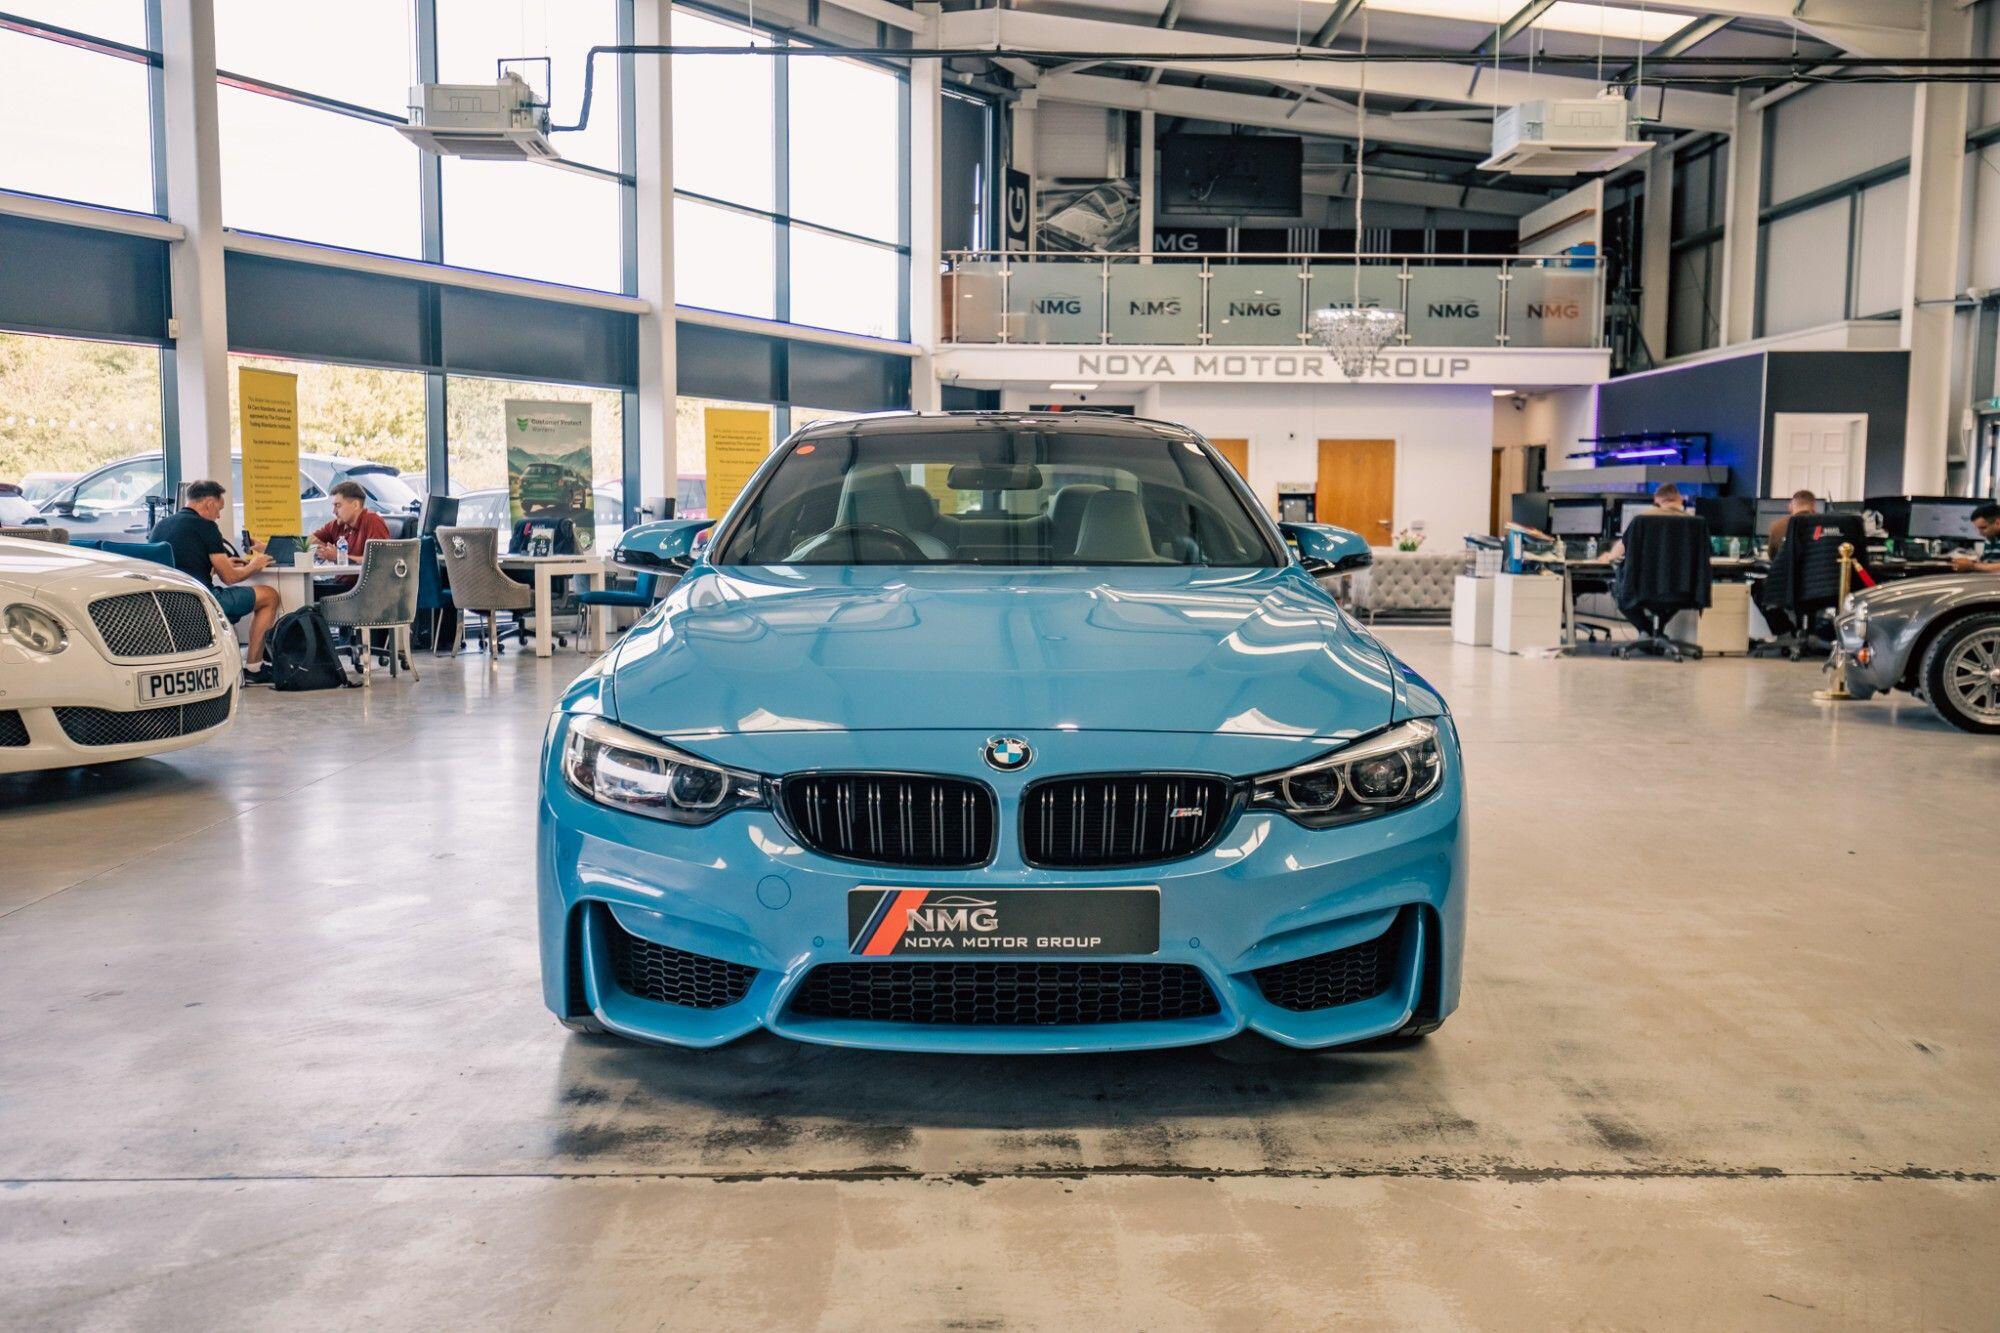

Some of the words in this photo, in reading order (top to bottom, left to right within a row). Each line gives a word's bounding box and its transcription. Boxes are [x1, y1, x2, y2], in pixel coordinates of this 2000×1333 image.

[1155, 233, 1199, 252] MG
[1032, 300, 1081, 315] NMG
[1130, 301, 1181, 316] NMG
[1229, 301, 1281, 317] NMG
[1428, 304, 1480, 318] NMG
[1528, 304, 1579, 319] NMG
[1079, 354, 1175, 375] NOYA
[1194, 355, 1323, 377] MOTOR
[1357, 357, 1470, 377] ROUP
[151, 667, 219, 697] PO59KER
[906, 908, 998, 932] NMG
[905, 937, 955, 948] NOYA
[962, 937, 1028, 948] MOTOR
[1036, 937, 1102, 948] GROUP
